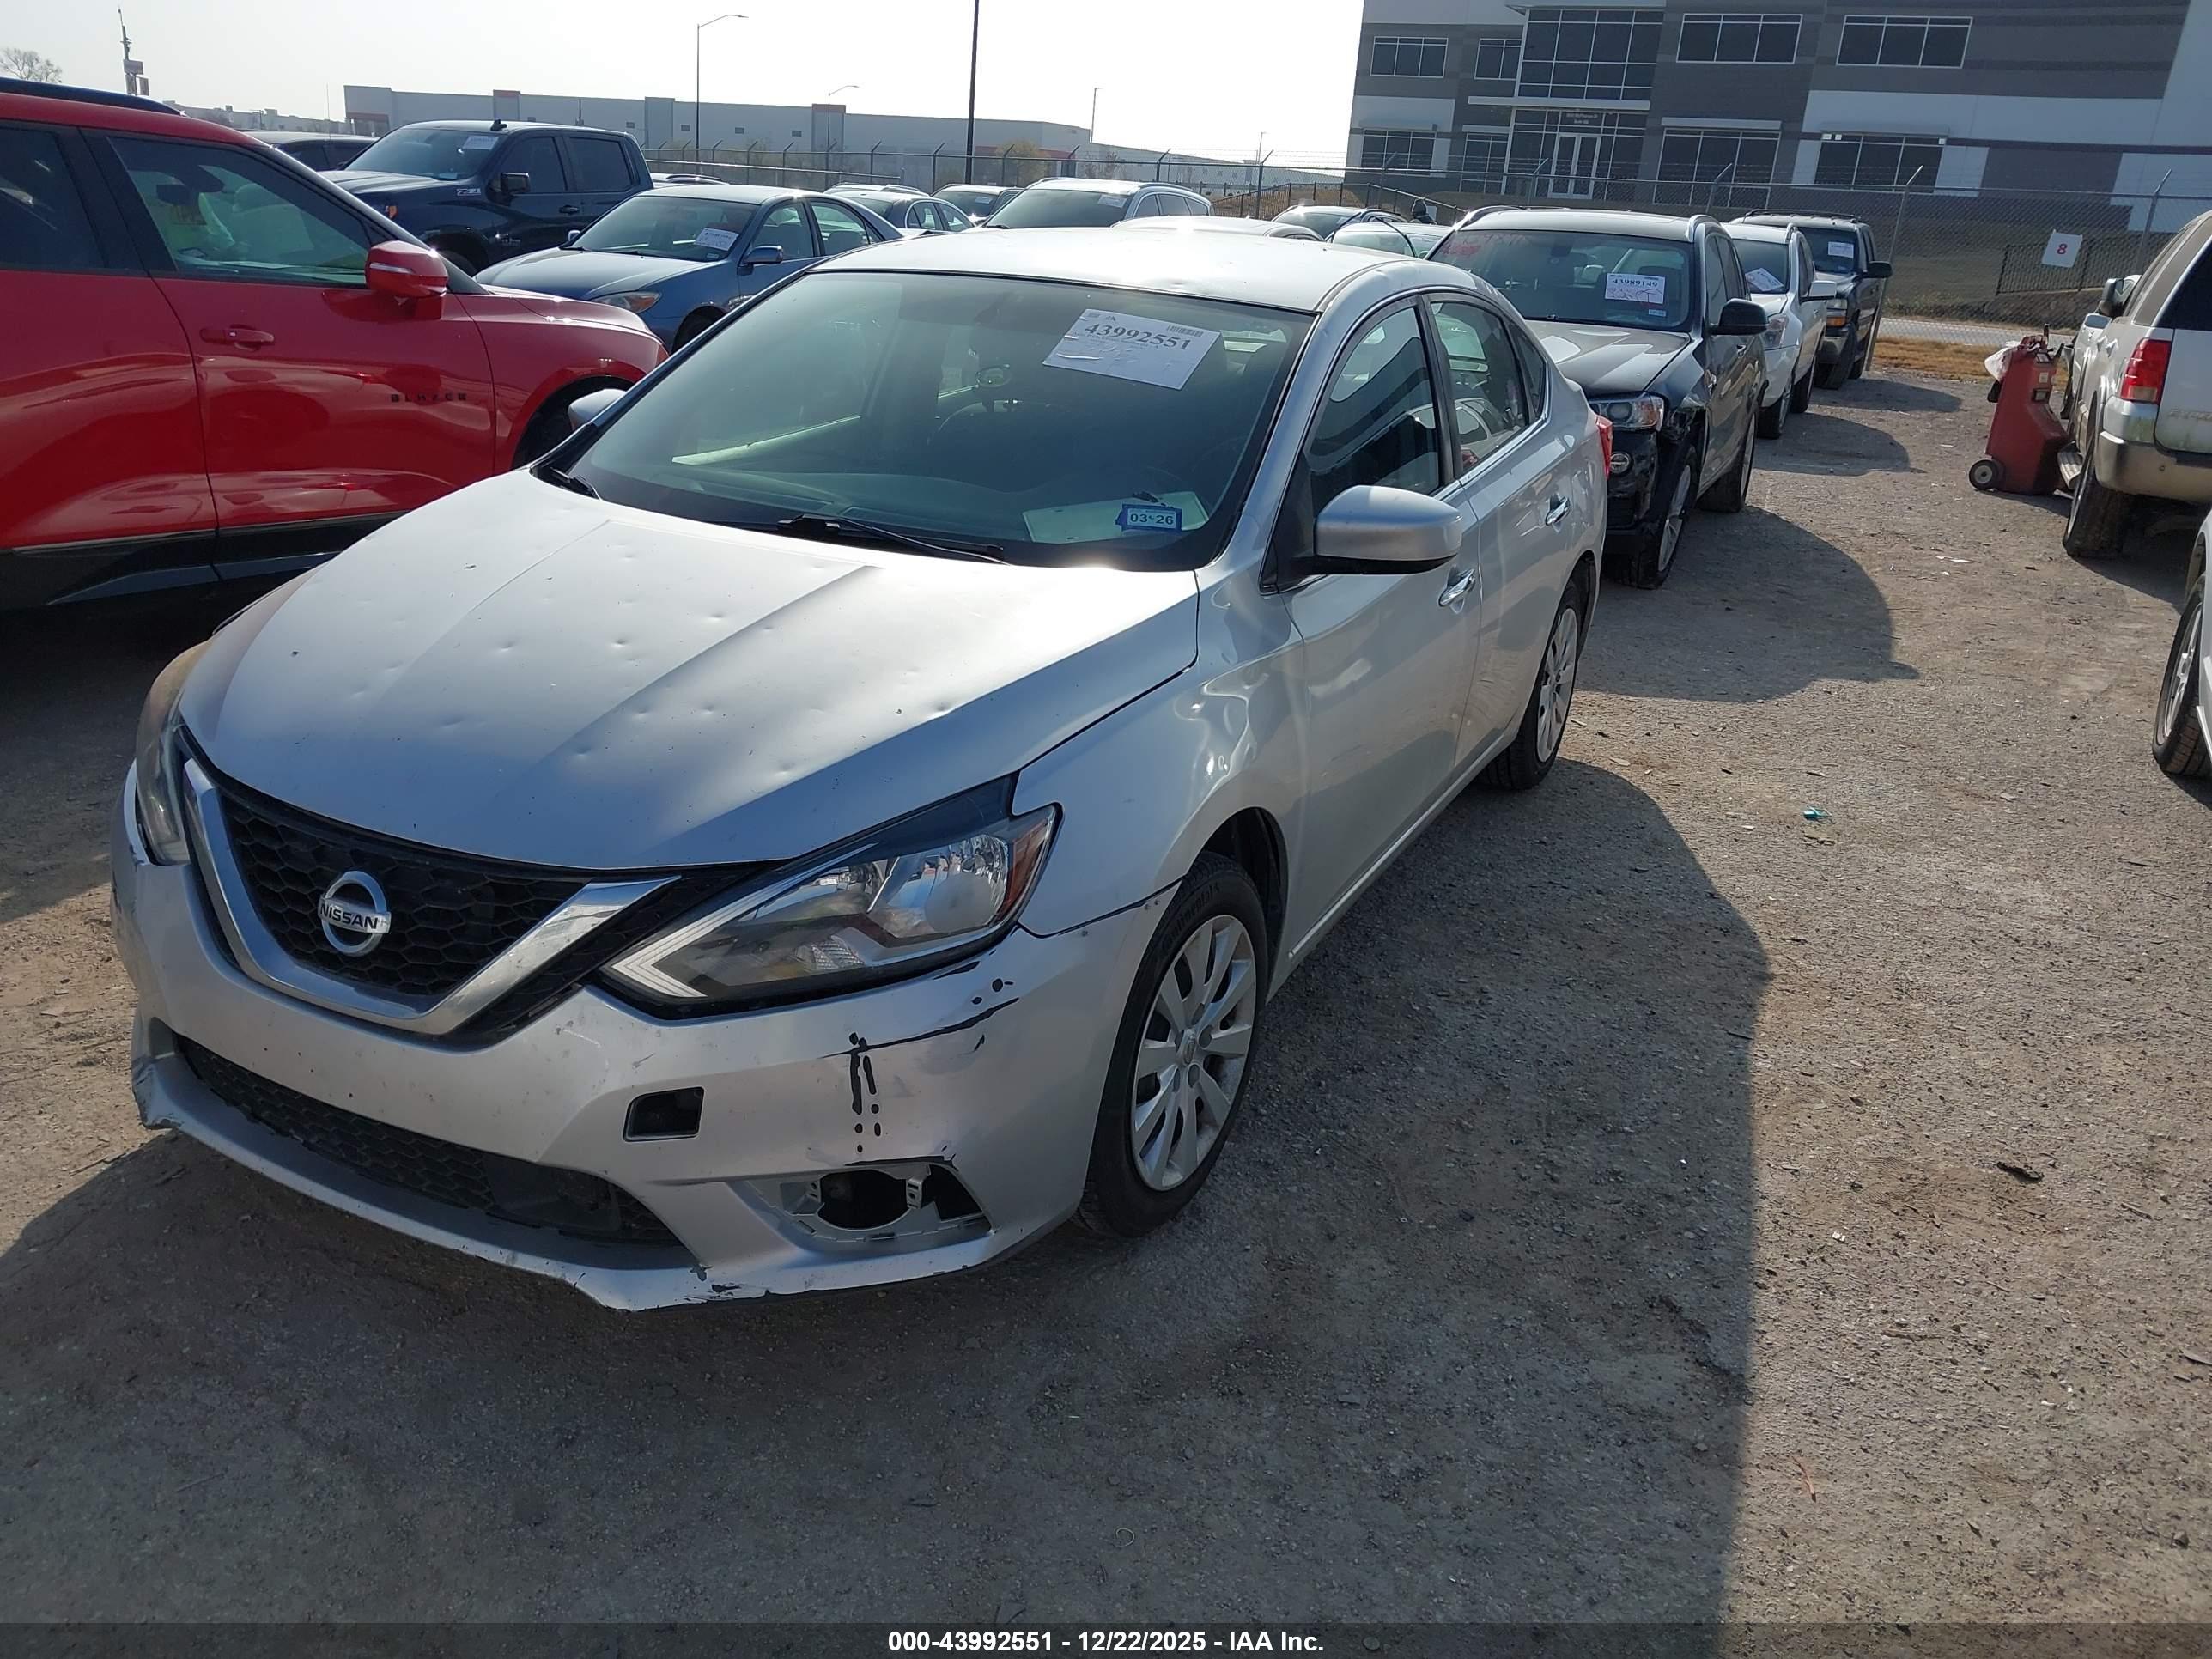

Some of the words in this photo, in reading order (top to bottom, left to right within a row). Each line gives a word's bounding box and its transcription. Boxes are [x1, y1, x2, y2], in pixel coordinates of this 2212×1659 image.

[2056, 243, 2069, 255] 8
[1085, 322, 1193, 351] 43992551
[1129, 513, 1149, 524] 03
[1155, 514, 1174, 526] 26
[319, 901, 380, 930] NISSAN
